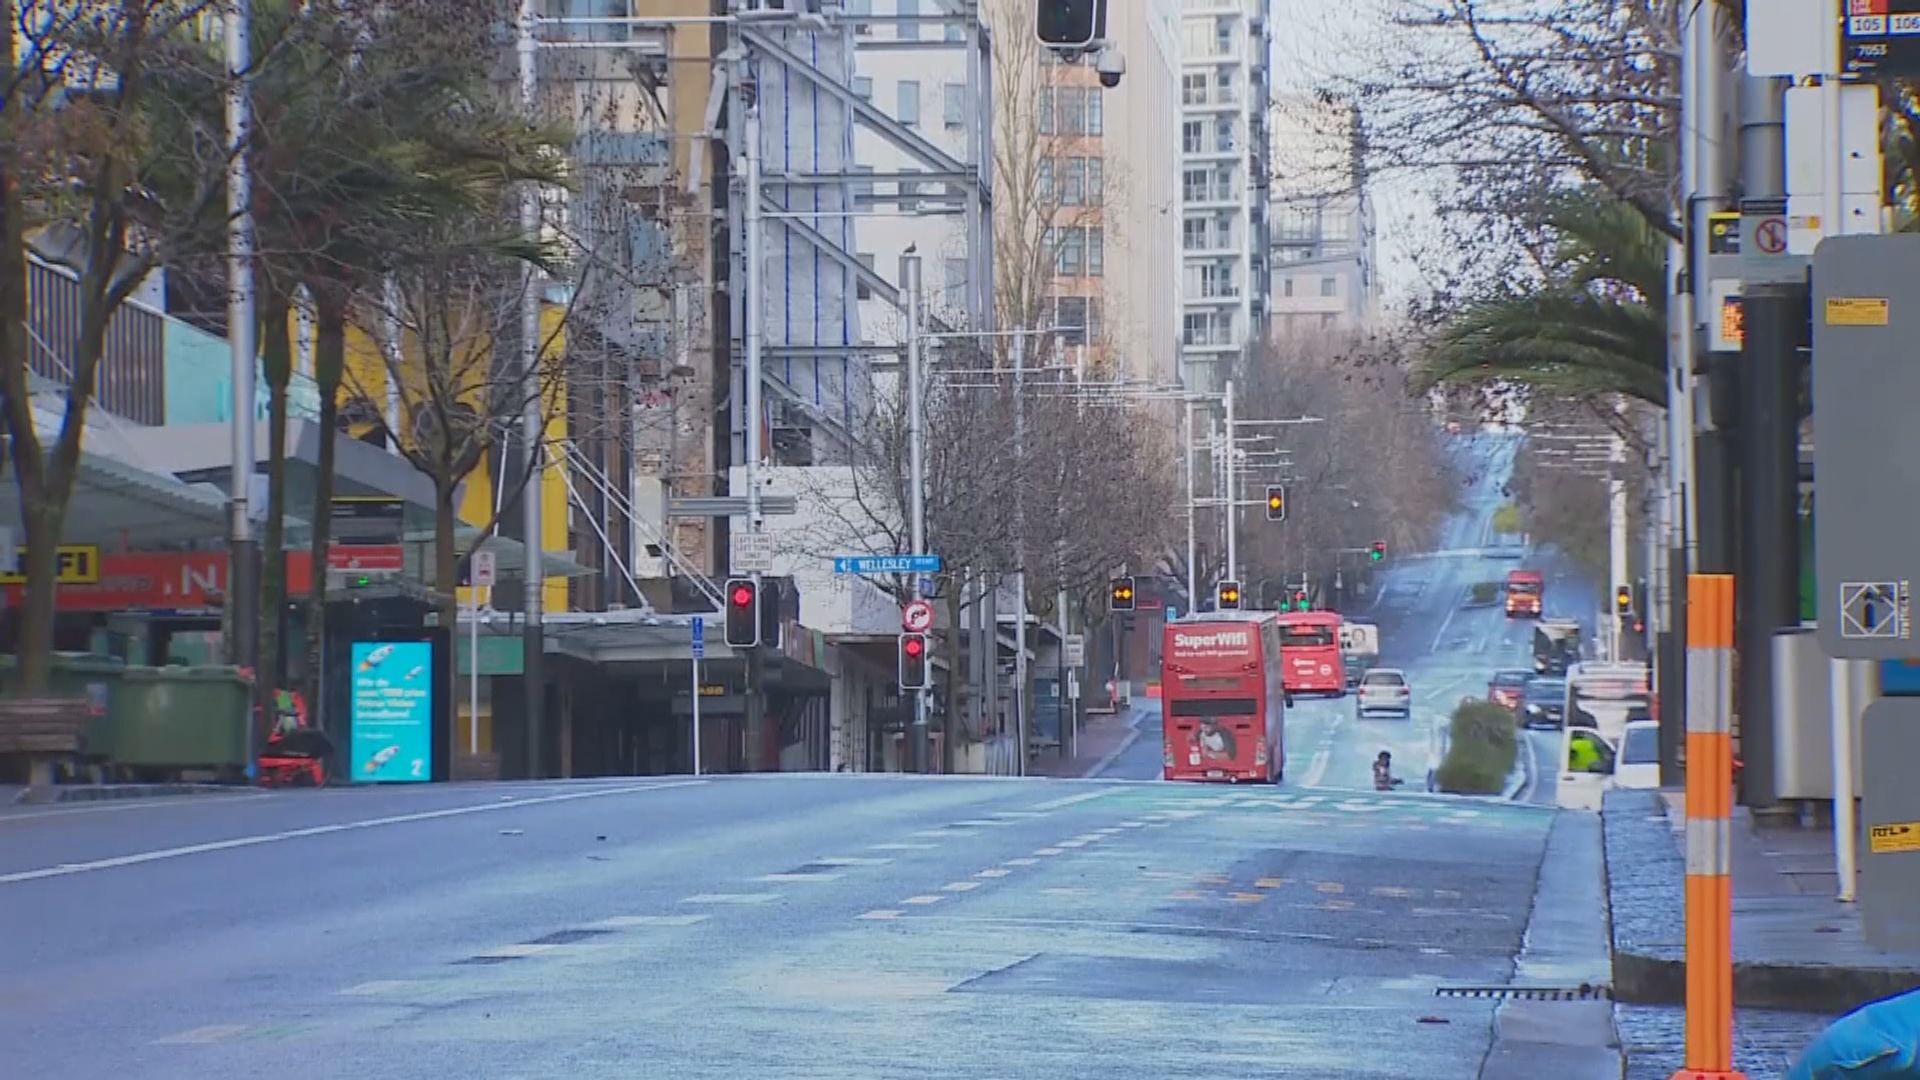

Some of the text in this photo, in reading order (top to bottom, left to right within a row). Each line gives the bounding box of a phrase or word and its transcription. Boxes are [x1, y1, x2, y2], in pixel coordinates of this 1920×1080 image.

[1855, 17, 1880, 32] 105
[1858, 44, 1888, 57] 7053
[859, 558, 911, 571] WELLESLEY
